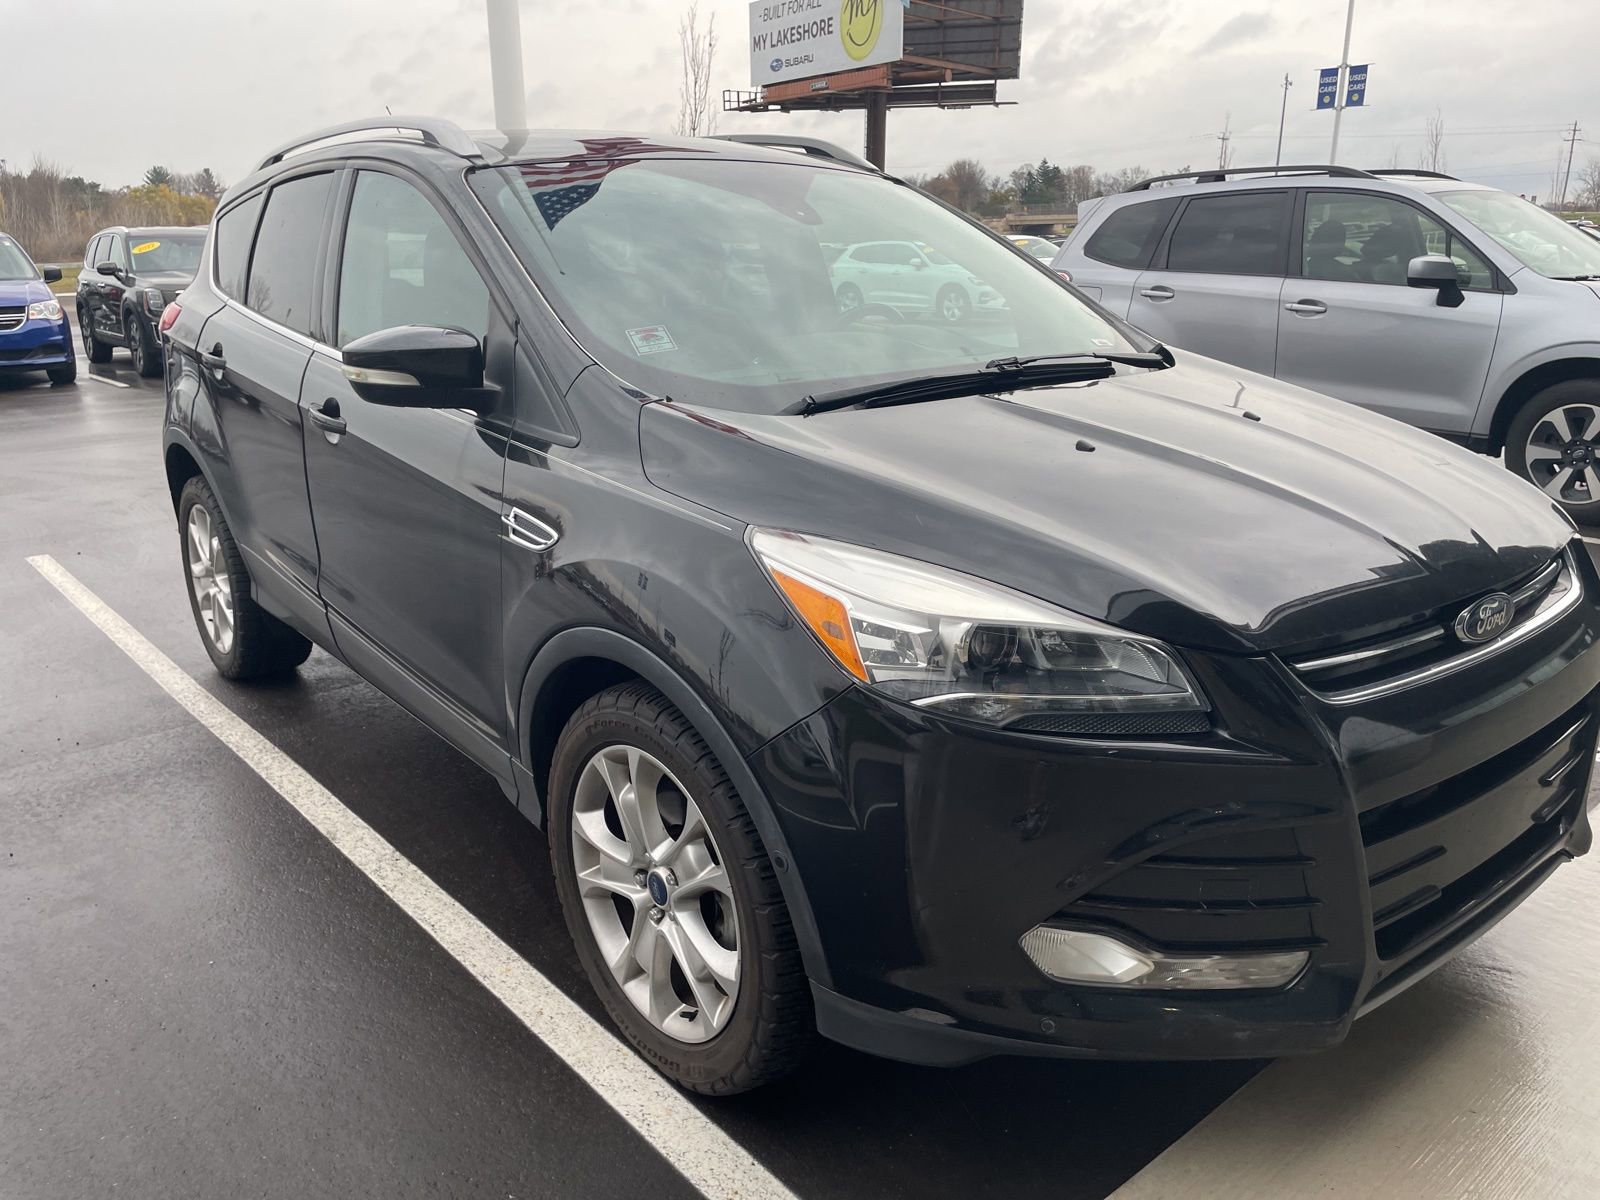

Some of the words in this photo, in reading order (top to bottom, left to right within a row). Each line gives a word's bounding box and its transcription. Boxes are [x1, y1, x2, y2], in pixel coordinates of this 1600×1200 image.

[787, 0, 804, 16] FOR
[753, 33, 768, 52] MY
[770, 17, 834, 49] LAKESHORE
[784, 54, 814, 68] SUBARU
[1320, 76, 1337, 84] USED
[1349, 73, 1367, 81] USED
[1319, 85, 1337, 93] CARS
[1348, 83, 1366, 91] CARS
[1477, 601, 1507, 634] Ford
